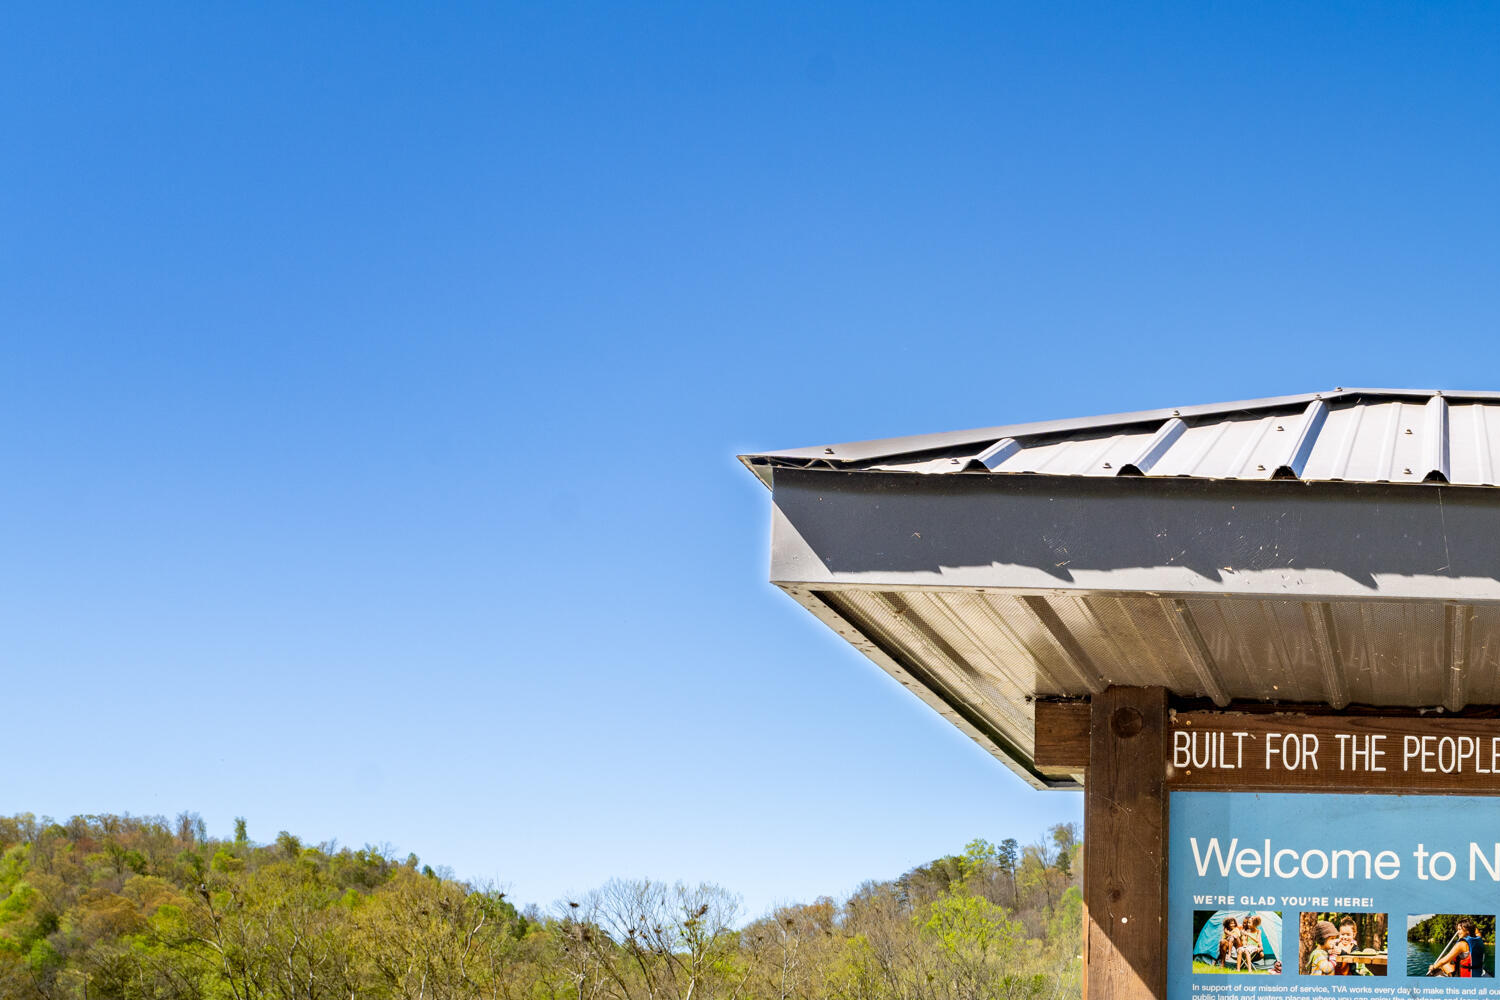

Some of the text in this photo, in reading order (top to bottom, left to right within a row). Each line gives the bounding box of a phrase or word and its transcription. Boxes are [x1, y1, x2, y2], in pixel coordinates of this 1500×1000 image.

[1173, 731, 1249, 769] BUILT
[1265, 732, 1319, 771] FOR
[1334, 734, 1387, 772] THE
[1190, 837, 1401, 880] Welcome
[1413, 843, 1457, 881] to
[1193, 896, 1374, 908] WE'RE GLAD YOU'RE HERE!
[1202, 984, 1232, 993] support
[1290, 985, 1298, 993] of
[1300, 986, 1329, 994] service,
[1349, 986, 1372, 994] works
[1374, 988, 1395, 996] every
[1396, 987, 1411, 996] day
[1423, 987, 1444, 995] make
[1446, 987, 1459, 995] this
[1462, 987, 1476, 995] and
